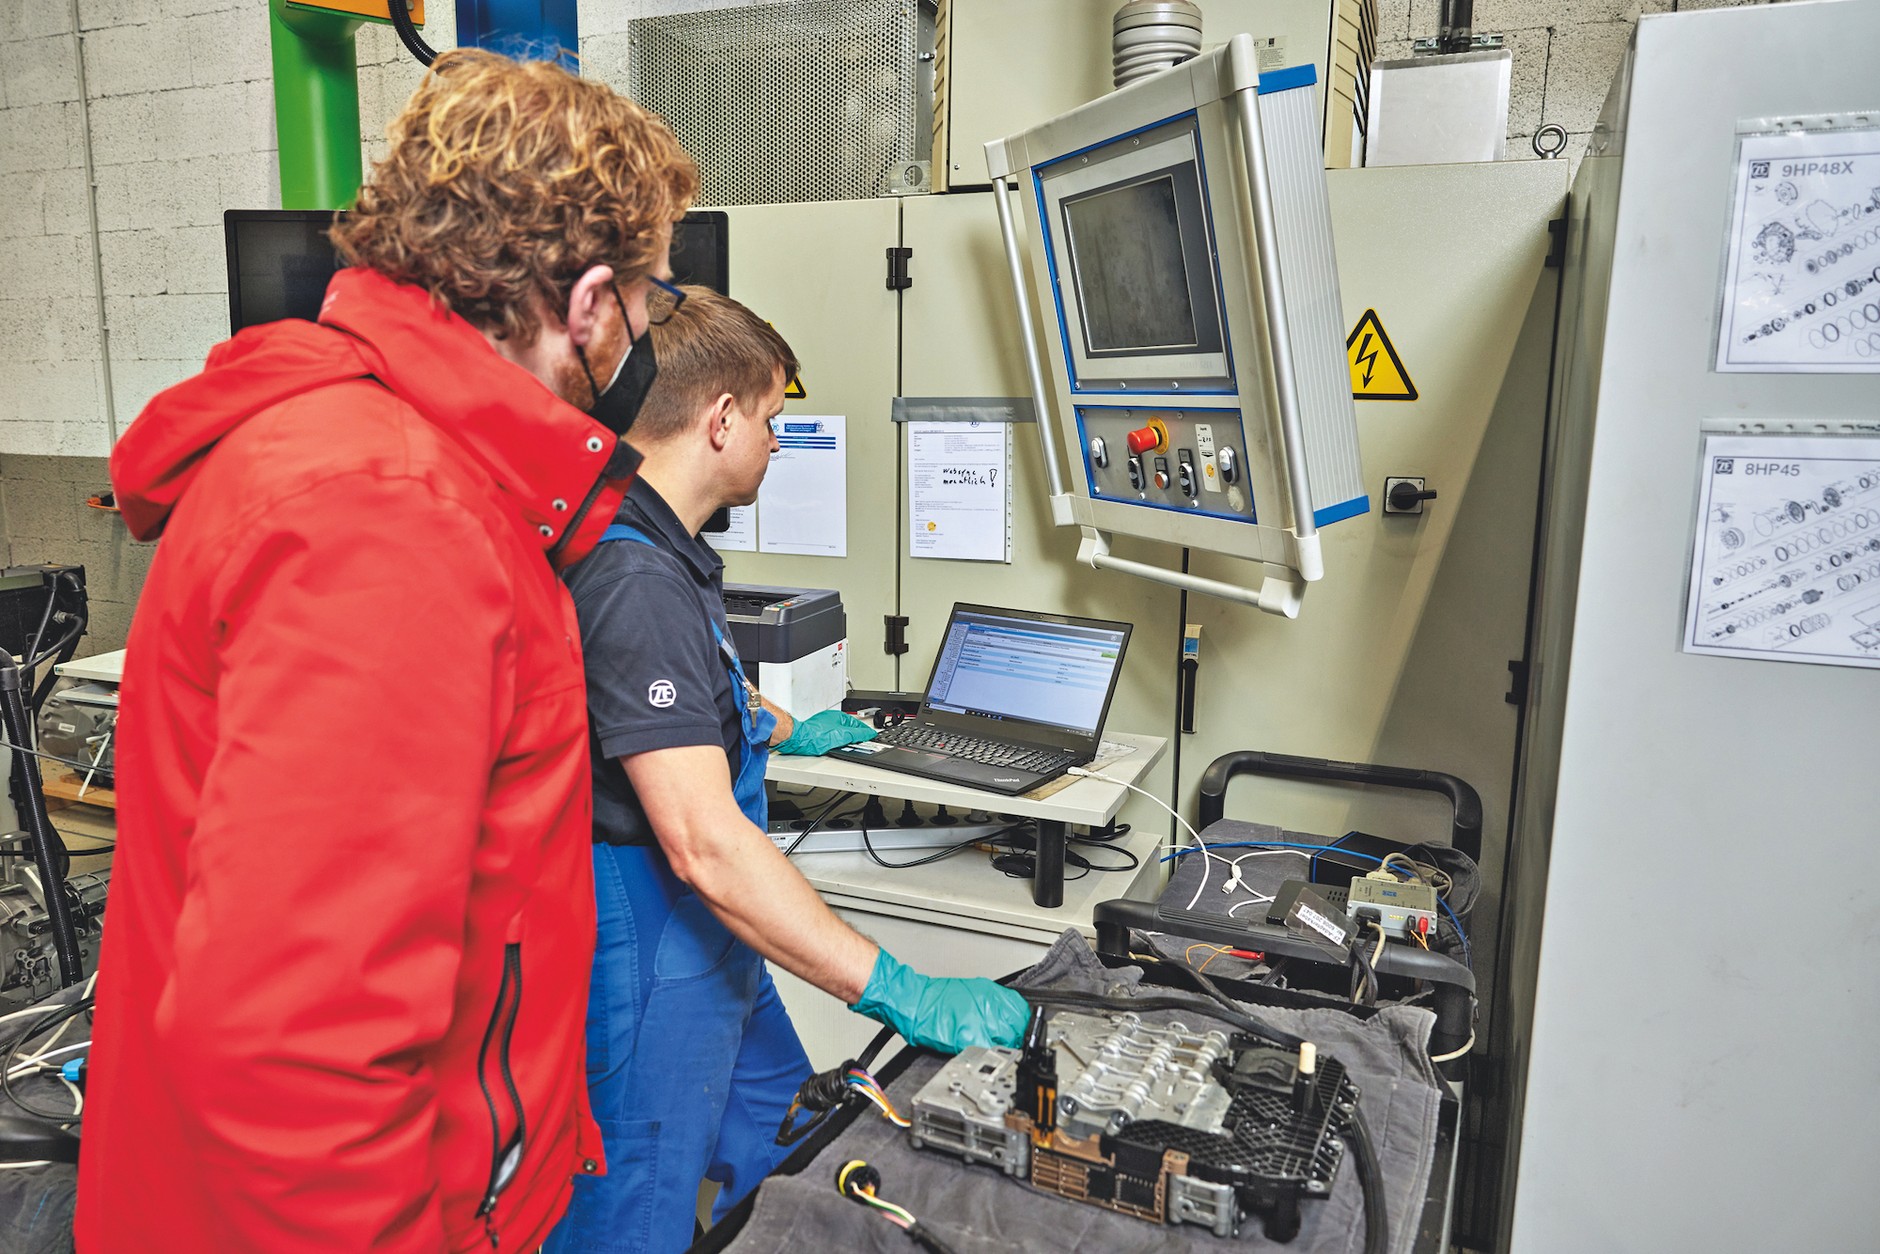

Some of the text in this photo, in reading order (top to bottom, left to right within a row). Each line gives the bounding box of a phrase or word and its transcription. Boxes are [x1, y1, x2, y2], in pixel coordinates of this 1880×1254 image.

[1782, 161, 1853, 177] 9HP48X
[989, 468, 998, 488] !
[1745, 463, 1799, 476] 8HP45
[650, 683, 675, 704] ZF
